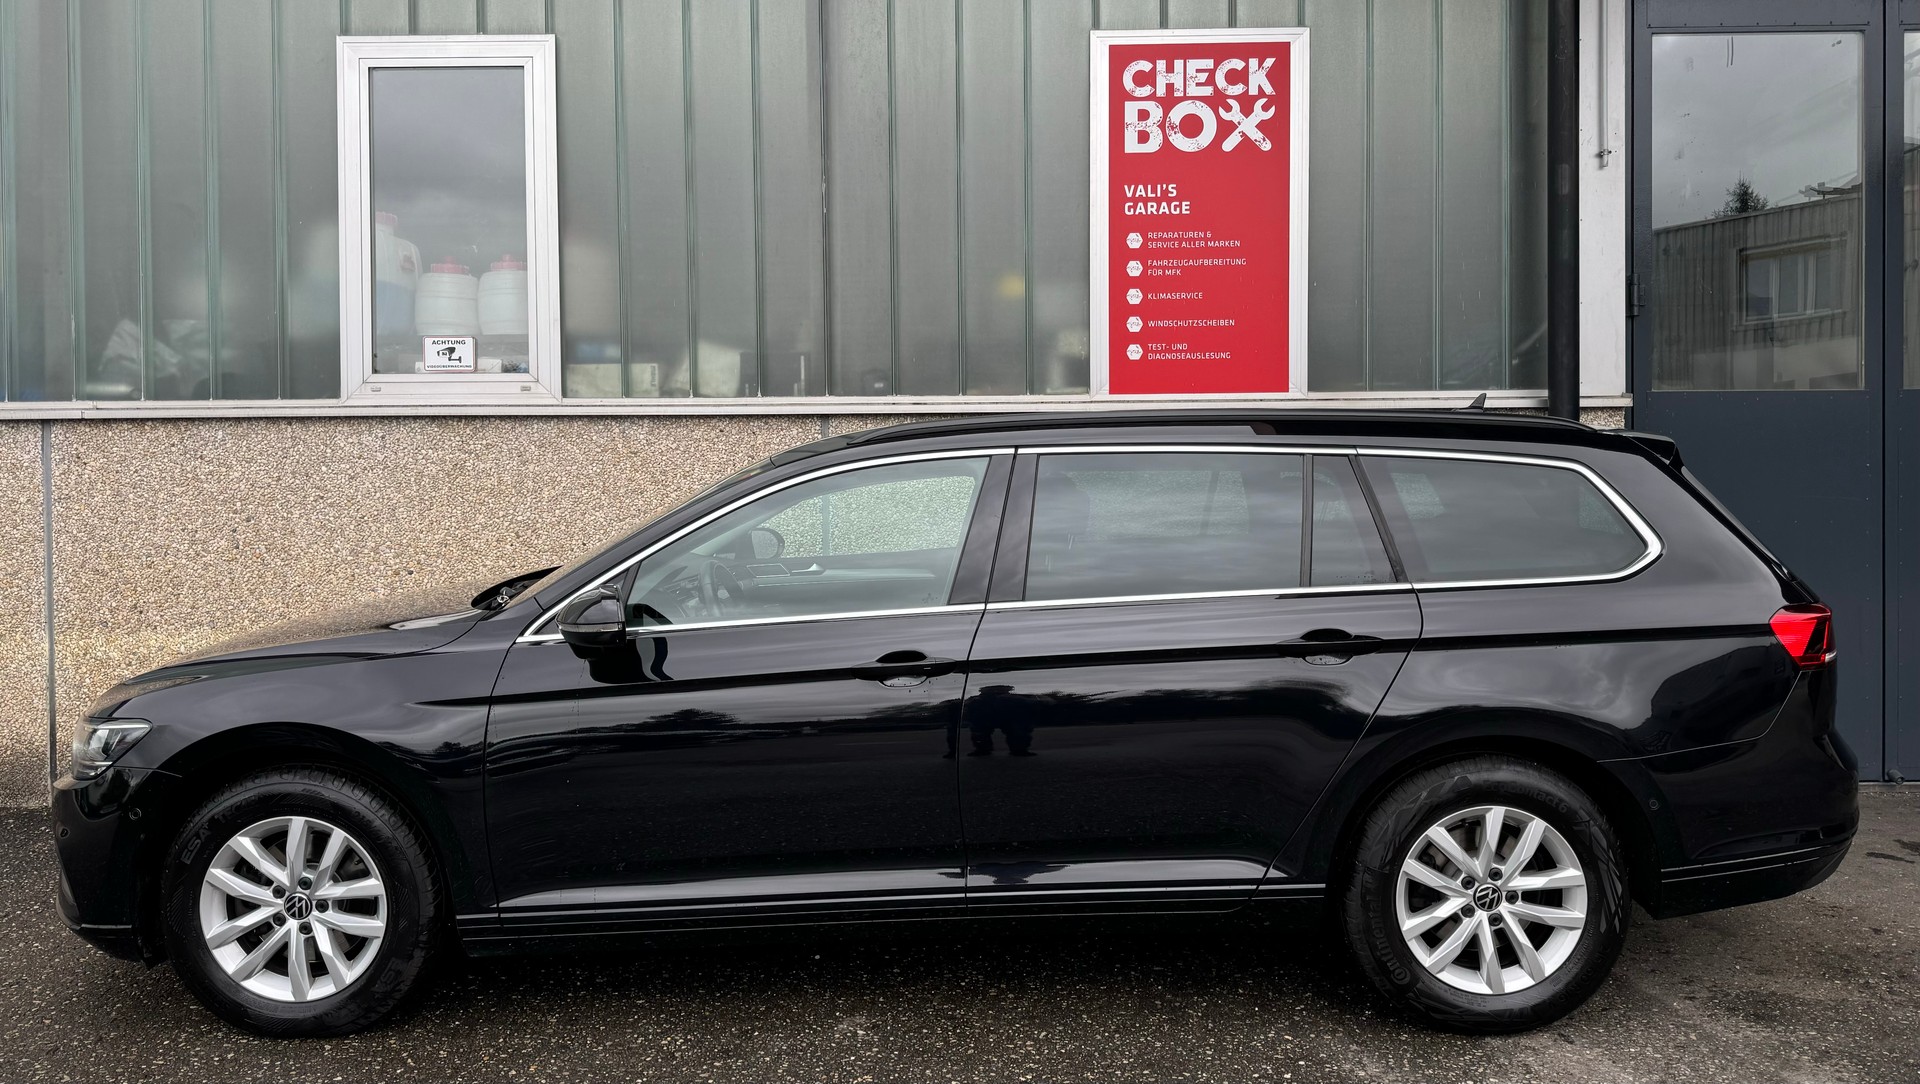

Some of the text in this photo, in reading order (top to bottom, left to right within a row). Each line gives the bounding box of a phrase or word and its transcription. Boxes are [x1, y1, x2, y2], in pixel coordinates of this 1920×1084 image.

[1122, 57, 1277, 98] CHECK
[1123, 184, 1177, 198] VALI'S
[1124, 201, 1191, 215] GARAGE
[1148, 231, 1205, 239] REPARATUREN
[1148, 240, 1241, 249] SERVICE ALLER MARKEN
[1148, 268, 1163, 276] FÜR
[1148, 292, 1203, 300] KLIMASERVICE
[1148, 319, 1235, 327] WINDSCHUTZSCHEIBEN
[1148, 352, 1231, 360] DIAGNOSEAUSLESUNG
